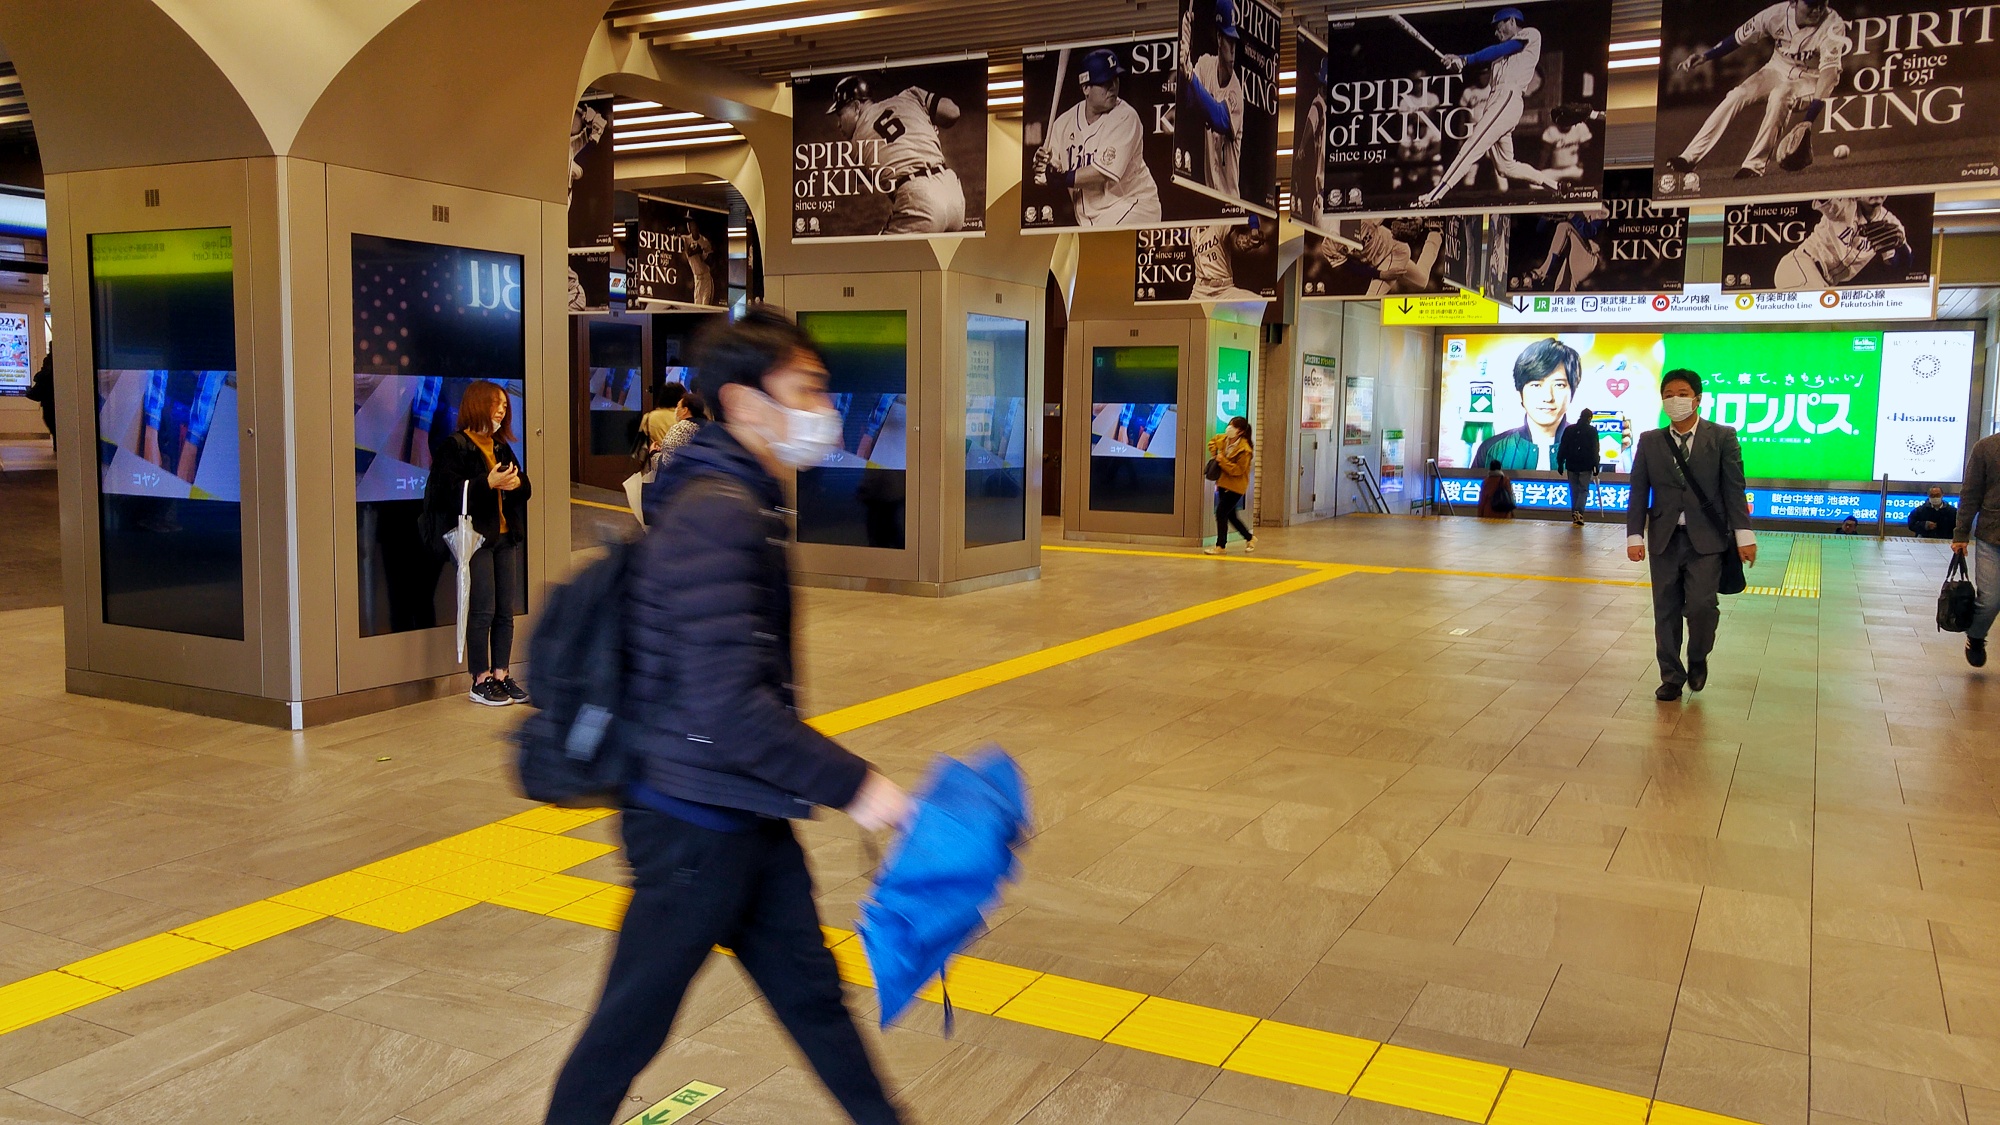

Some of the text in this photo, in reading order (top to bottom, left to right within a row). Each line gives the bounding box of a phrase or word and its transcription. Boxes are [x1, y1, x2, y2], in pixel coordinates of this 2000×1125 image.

[1828, 4, 2000, 58] SPIRIT
[1266, 53, 1278, 83] of
[1903, 53, 1948, 70] since
[1854, 53, 1903, 93] of
[1903, 69, 1934, 87] 1951
[1241, 65, 1278, 116] KING
[1330, 72, 1464, 114] SPIRIT
[1819, 85, 1965, 134] KING
[873, 109, 906, 143] 6
[1328, 107, 1474, 148] of KING
[795, 138, 887, 171] SPIRIT
[1329, 148, 1387, 164] since 1951
[1962, 168, 1990, 176] DAIBO
[794, 167, 898, 198] of KING
[795, 200, 836, 212] since 1951
[1727, 204, 1756, 224] of
[1753, 206, 1798, 218] since 1951
[1618, 224, 1658, 234] since 1951
[1660, 217, 1686, 238] of
[1726, 220, 1807, 246] KING
[640, 230, 684, 254] SPIRIT
[1610, 238, 1684, 260] KING
[648, 250, 660, 266] of
[1138, 247, 1156, 266] of
[1155, 251, 1186, 260] since 1951
[1206, 251, 1218, 262] 18
[640, 264, 677, 285] KING
[1137, 264, 1192, 284] KING
[1566, 296, 1576, 305] 線
[1600, 296, 1646, 305] 東武東上線
[1671, 294, 1710, 304] 丸ノ内線
[1756, 291, 1798, 302] 有楽町線
[1841, 290, 1886, 300] 副都心線
[1536, 299, 1548, 310] JR
[1585, 300, 1597, 309] TJ
[1756, 302, 1795, 310] Yurakucho
[1840, 299, 1903, 308] Fukutoshin Line
[1887, 412, 1957, 423] Hisamitsu
[822, 453, 844, 462] コヤシ
[1110, 446, 1128, 454] コヤシ
[132, 472, 160, 488] コヤシ
[396, 476, 427, 490] コヤシ
[1440, 480, 1568, 506] 駿台備学校
[1772, 493, 1860, 506] 駿台中学部 池袋校
[1770, 505, 1878, 519] 駿台個別教育センター 池袋校
